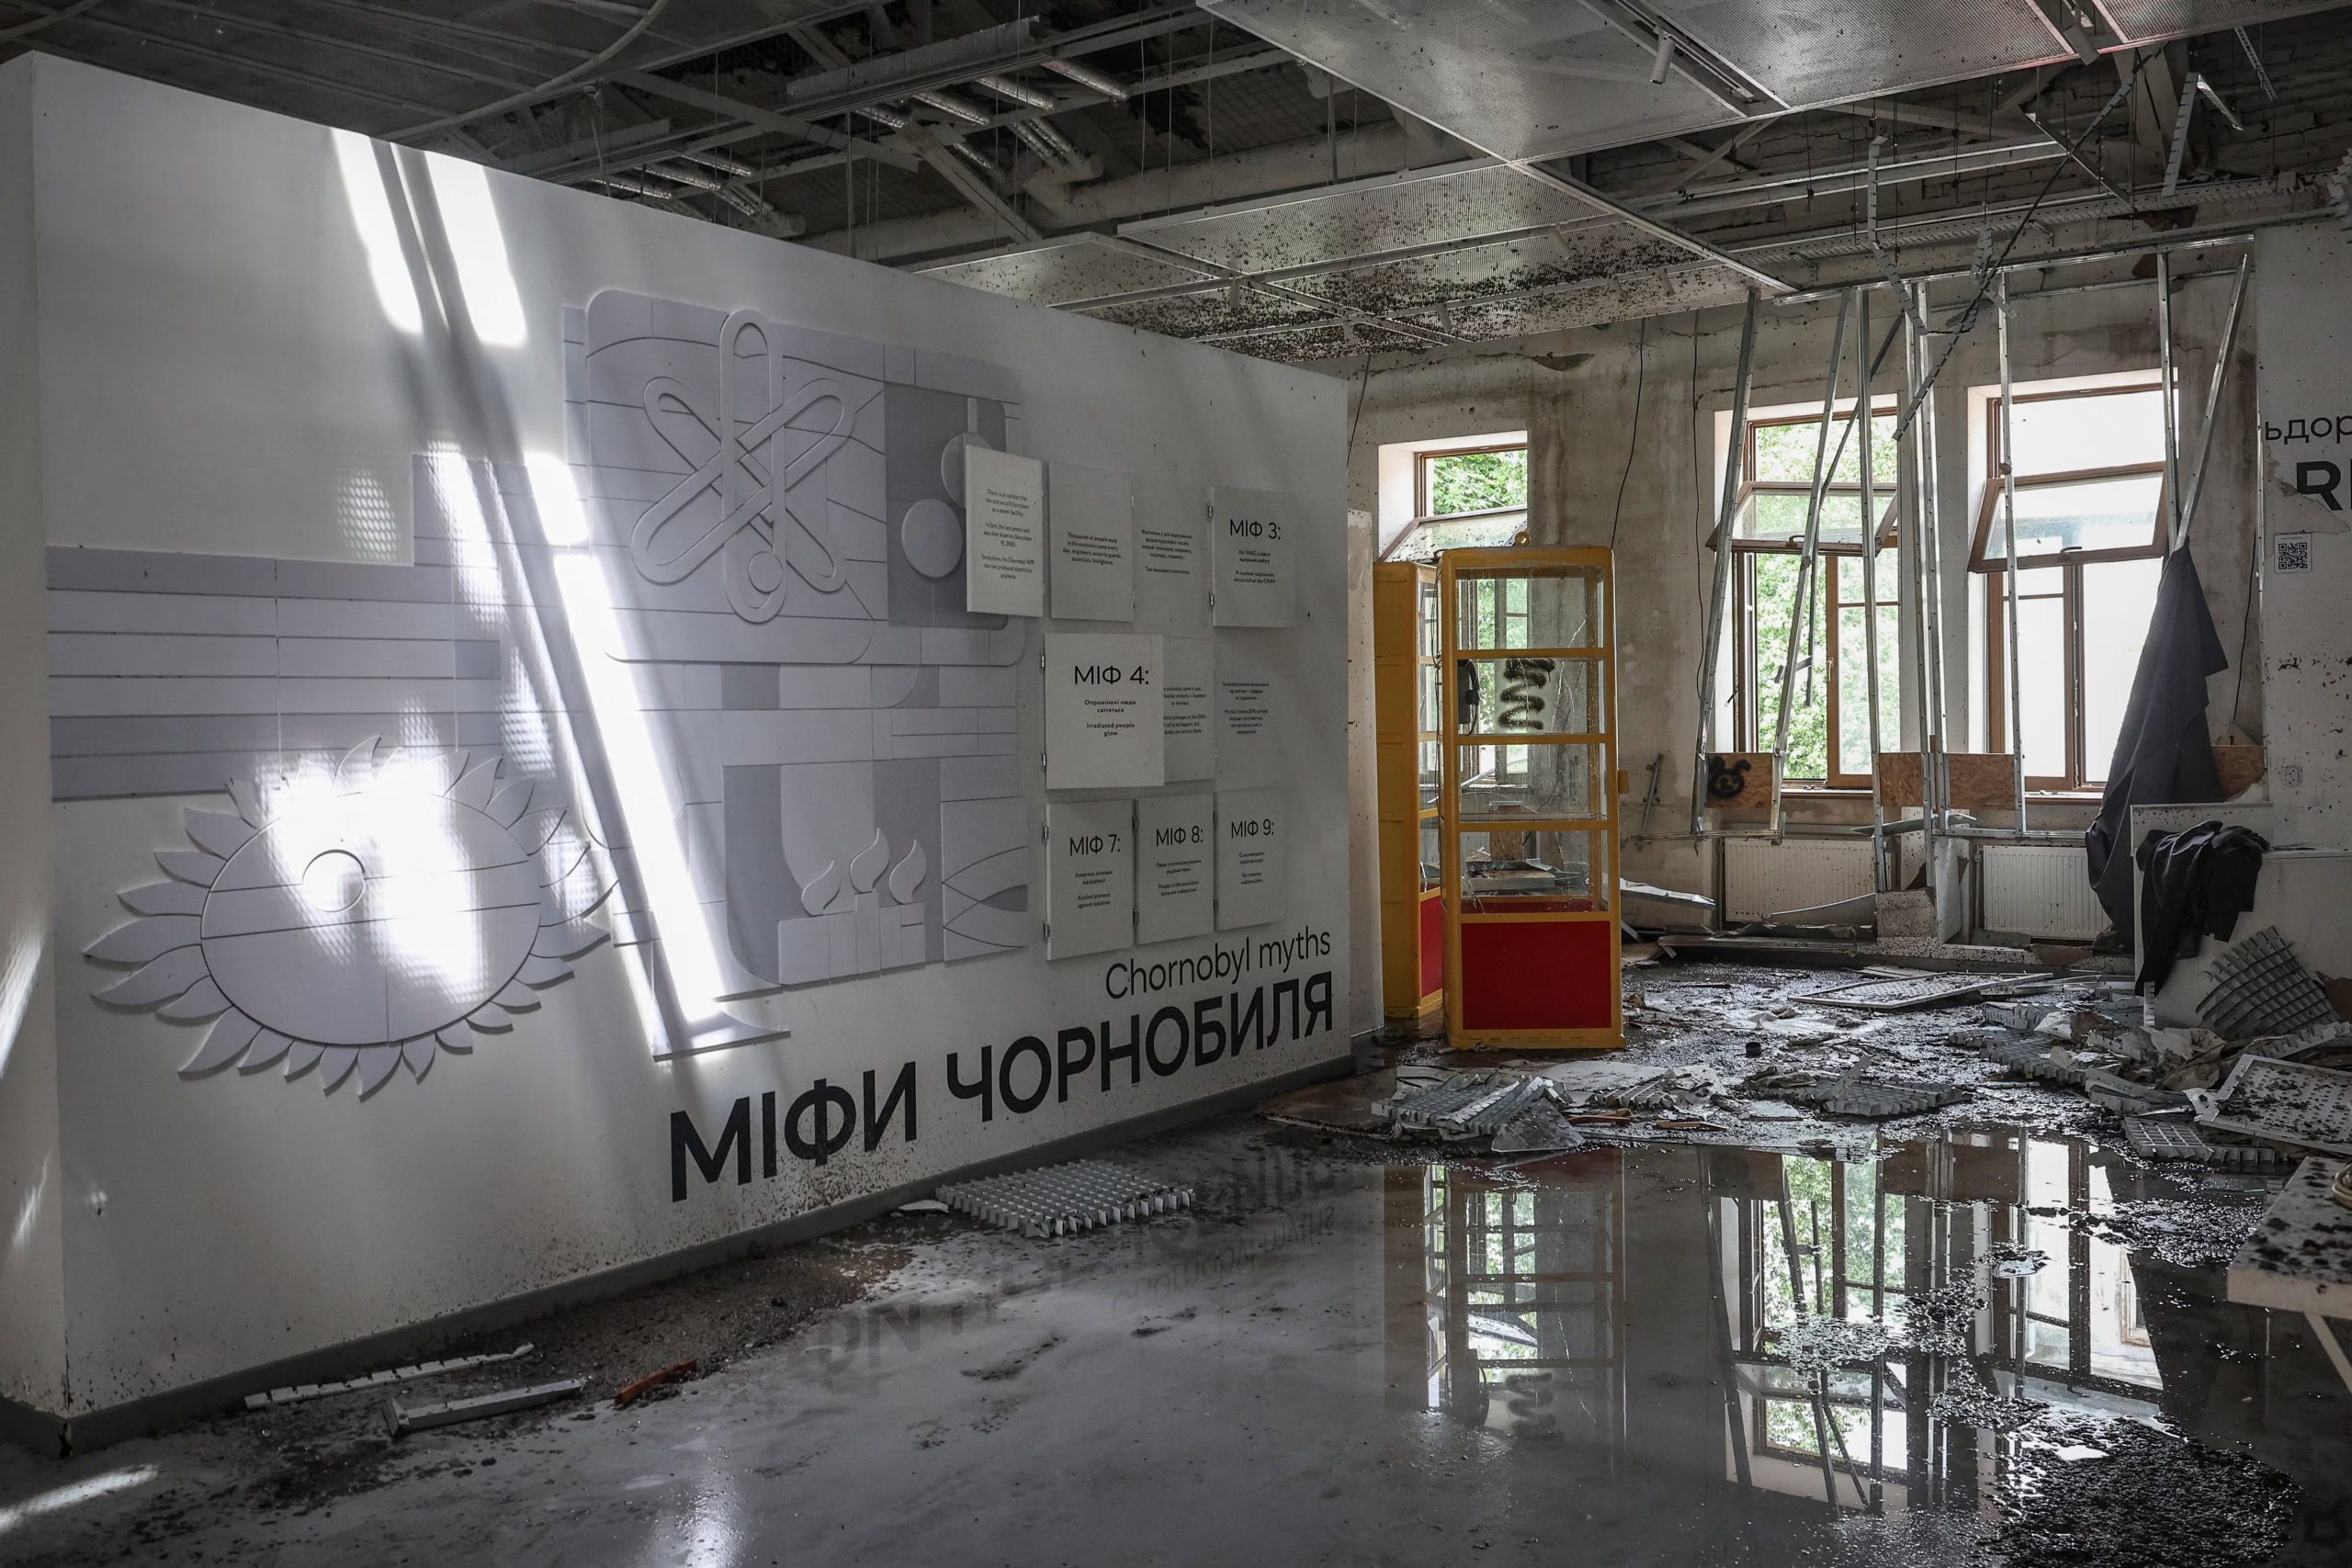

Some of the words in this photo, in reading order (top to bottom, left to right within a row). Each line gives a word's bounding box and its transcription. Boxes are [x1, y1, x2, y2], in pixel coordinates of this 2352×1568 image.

[1230, 518, 1262, 538] МІФ
[1268, 522, 1281, 540] 3:
[1075, 665, 1121, 685] МІФ
[1130, 665, 1148, 685] 4:
[1156, 827, 1186, 847] МІФ
[1192, 825, 1203, 843] 8:
[1231, 819, 1259, 839] МІФ
[1263, 818, 1273, 836] 9:
[1069, 835, 1102, 856] МІФ
[1108, 834, 1120, 852] 7:
[1106, 937, 1250, 999] Chornobyl
[1259, 926, 1331, 977] myths
[672, 1062, 917, 1202] МІФИ
[946, 971, 1332, 1122] ЧОРНОБИЛЯ
